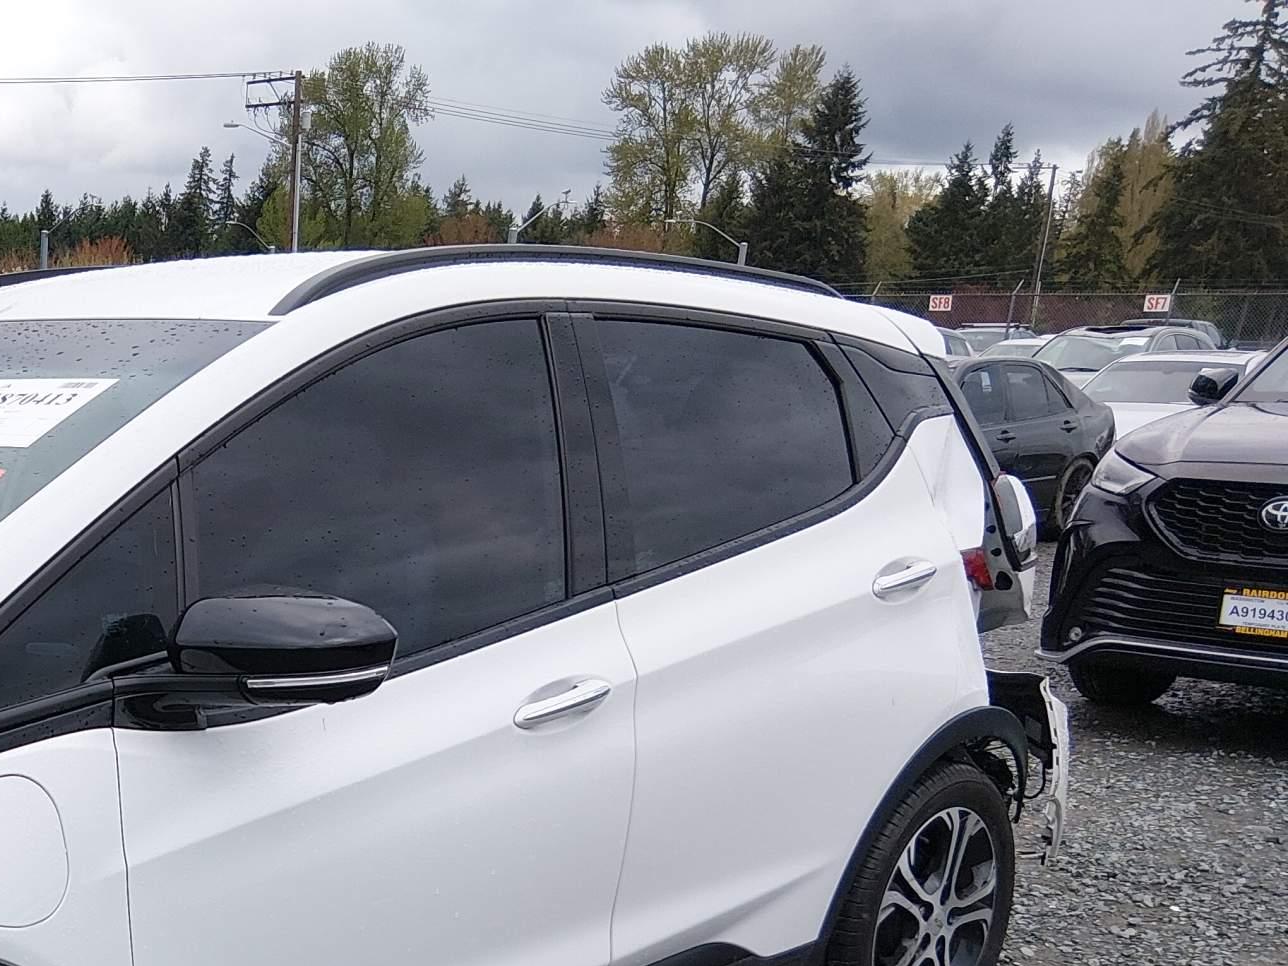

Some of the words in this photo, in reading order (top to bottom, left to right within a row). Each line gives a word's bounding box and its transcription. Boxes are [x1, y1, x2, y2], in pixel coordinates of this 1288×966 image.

[931, 296, 951, 310] SF8
[1147, 296, 1168, 310] SF7
[1235, 627, 1288, 638] BELLINGHAM
